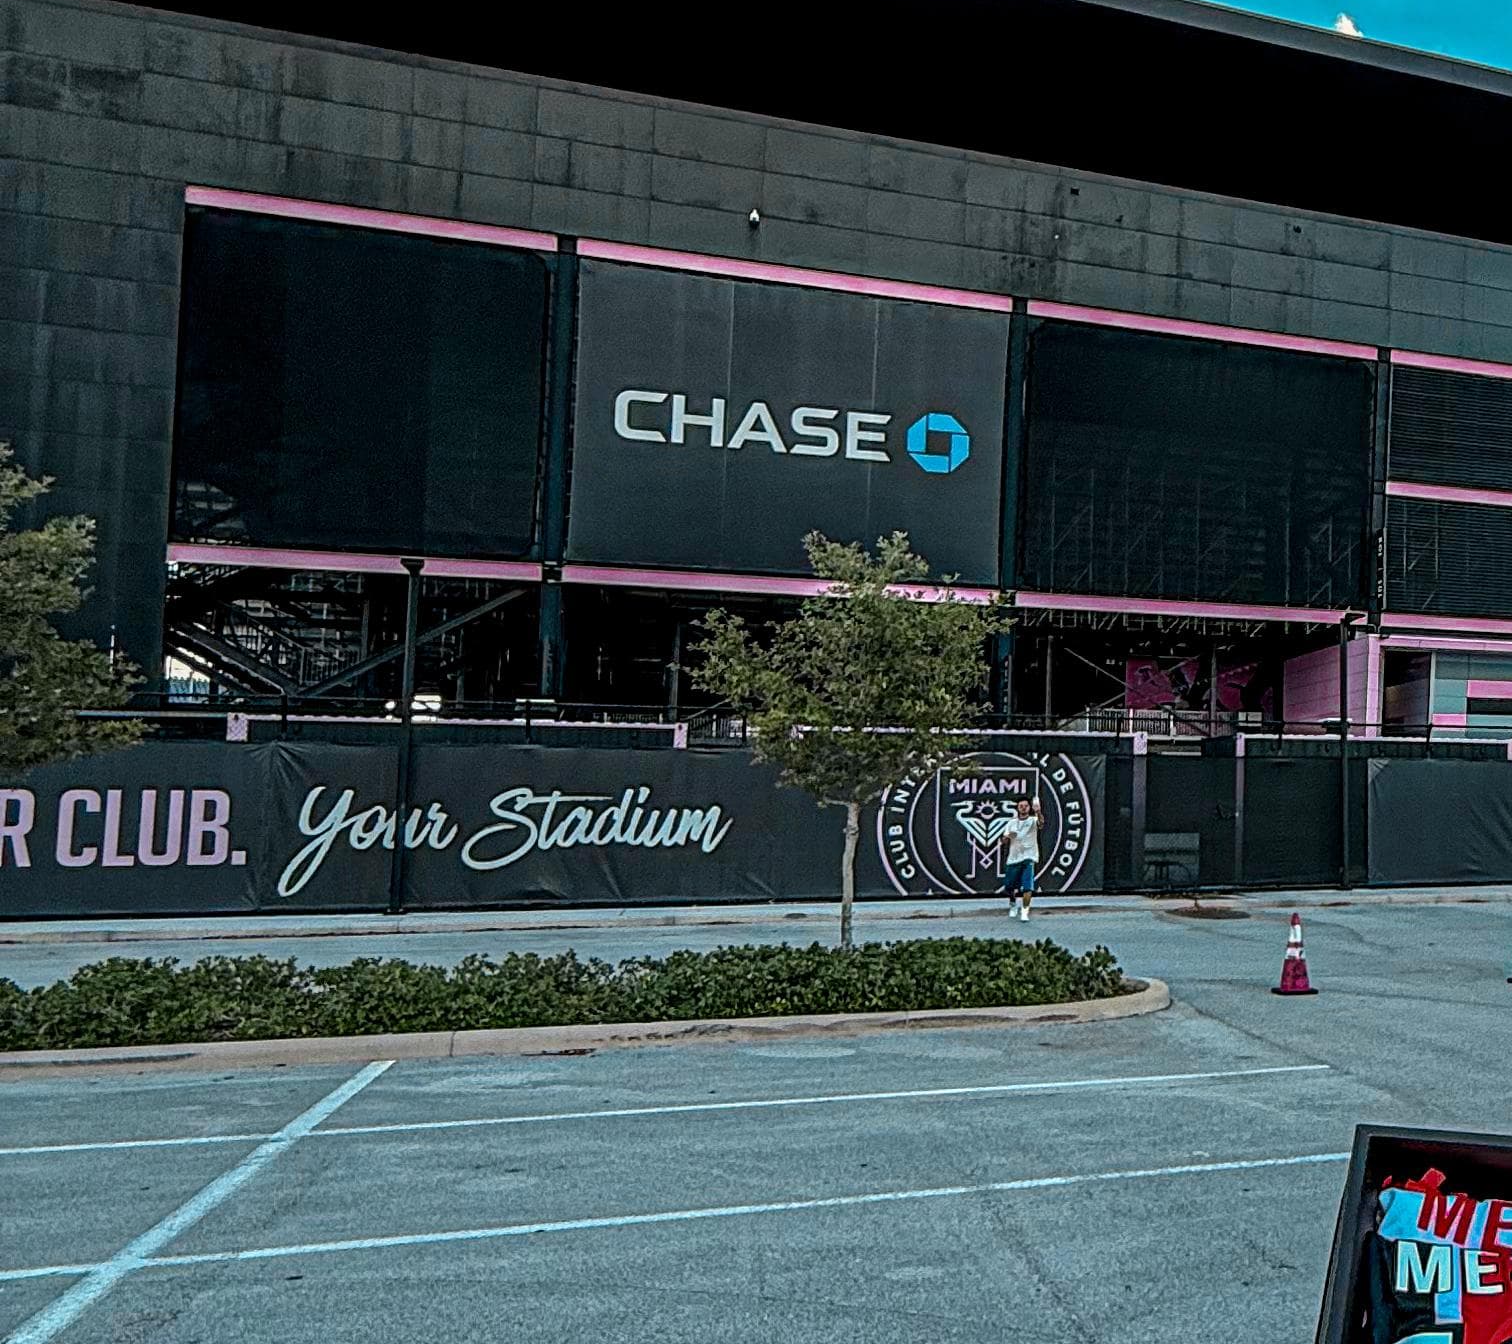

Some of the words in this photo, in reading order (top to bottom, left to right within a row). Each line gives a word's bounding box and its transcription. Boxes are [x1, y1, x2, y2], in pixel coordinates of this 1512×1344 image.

[614, 389, 892, 462] CHASE
[888, 824, 916, 880] CLUB
[1052, 768, 1074, 795] DE
[950, 778, 1028, 794] MIAMI
[56, 788, 247, 867] CLUB.
[278, 786, 458, 897] Your
[461, 786, 733, 870] Stadium
